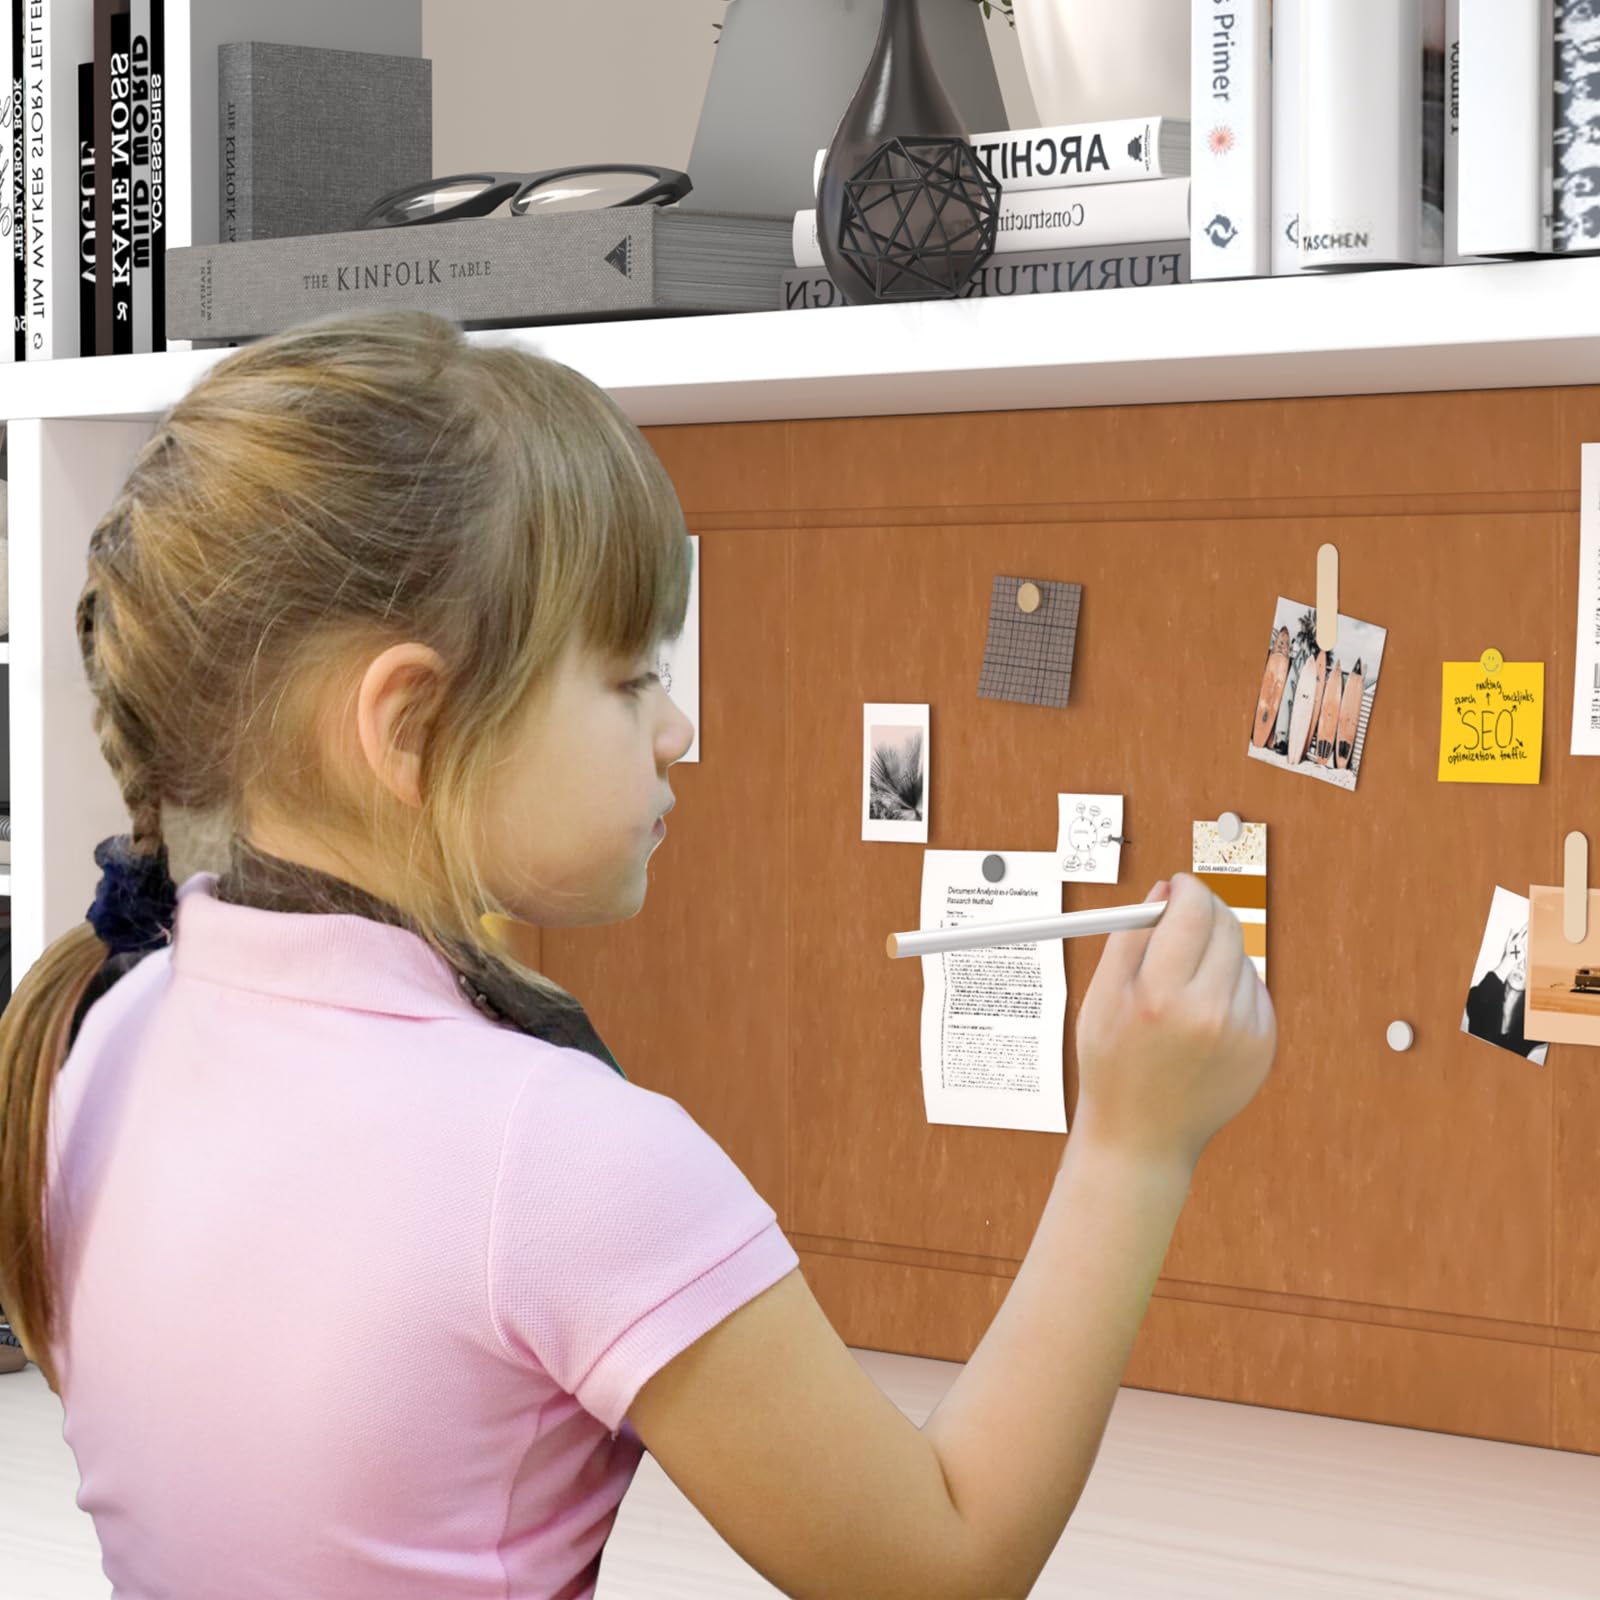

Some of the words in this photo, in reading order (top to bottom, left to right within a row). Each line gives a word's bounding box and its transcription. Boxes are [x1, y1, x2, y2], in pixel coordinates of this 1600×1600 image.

[1213, 13, 1235, 101] Primer
[1303, 232, 1368, 251] TASCHEN
[303, 274, 328, 289] THE
[337, 259, 442, 291] KINFOLK
[450, 260, 492, 278] TABLE
[1461, 708, 1514, 750] SEO
[1448, 751, 1497, 765] optimization
